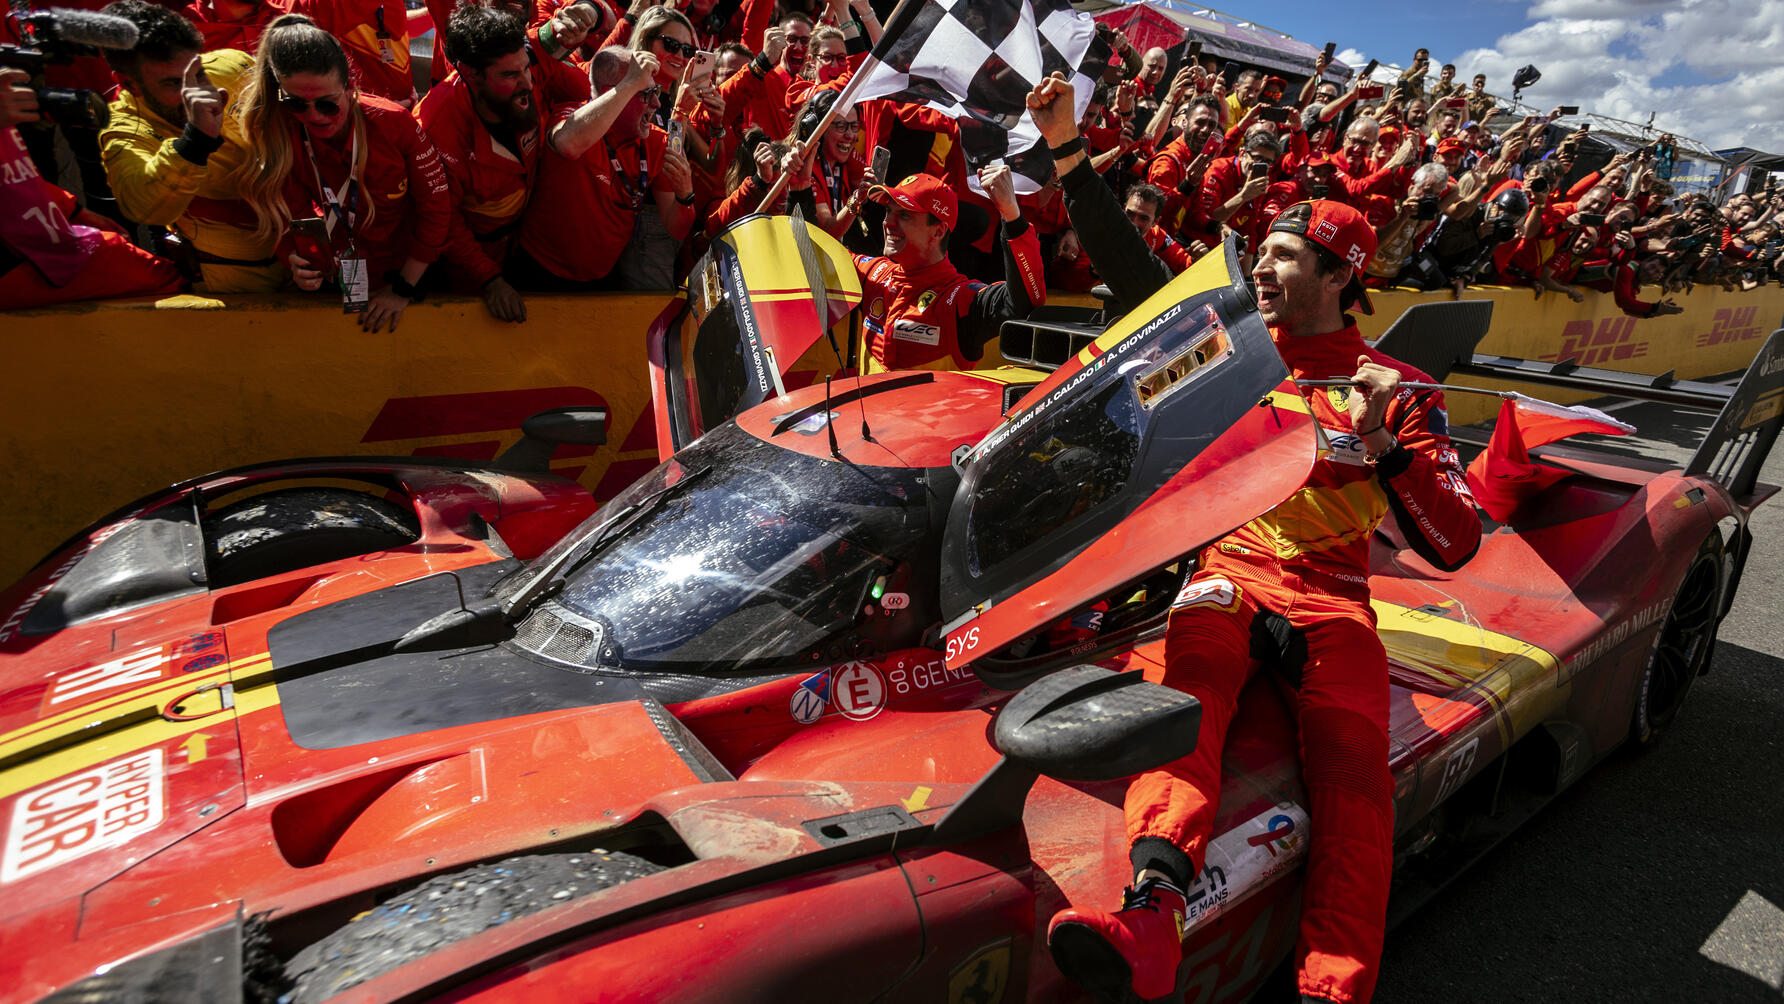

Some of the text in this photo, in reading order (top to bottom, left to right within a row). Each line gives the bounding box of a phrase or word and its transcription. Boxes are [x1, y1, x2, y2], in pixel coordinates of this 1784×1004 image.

[1346, 243, 1367, 269] 51
[896, 322, 937, 336] WEC
[991, 431, 1011, 451] PIER
[1010, 411, 1034, 432] GUIDI
[1045, 397, 1054, 408] J.
[1053, 367, 1095, 402] CALADO
[1105, 352, 1118, 364] A.
[1117, 303, 1182, 354] GIOVINAZZI
[1404, 491, 1425, 515] MILLE
[1420, 516, 1452, 549] RICHARD
[946, 626, 980, 661] SYS
[1570, 620, 1629, 676] RICHARD
[847, 677, 873, 709] E
[103, 755, 151, 837] HYPER
[17, 775, 102, 870] CAR
[1185, 905, 1197, 921] LE
[1199, 888, 1229, 913] MANS
